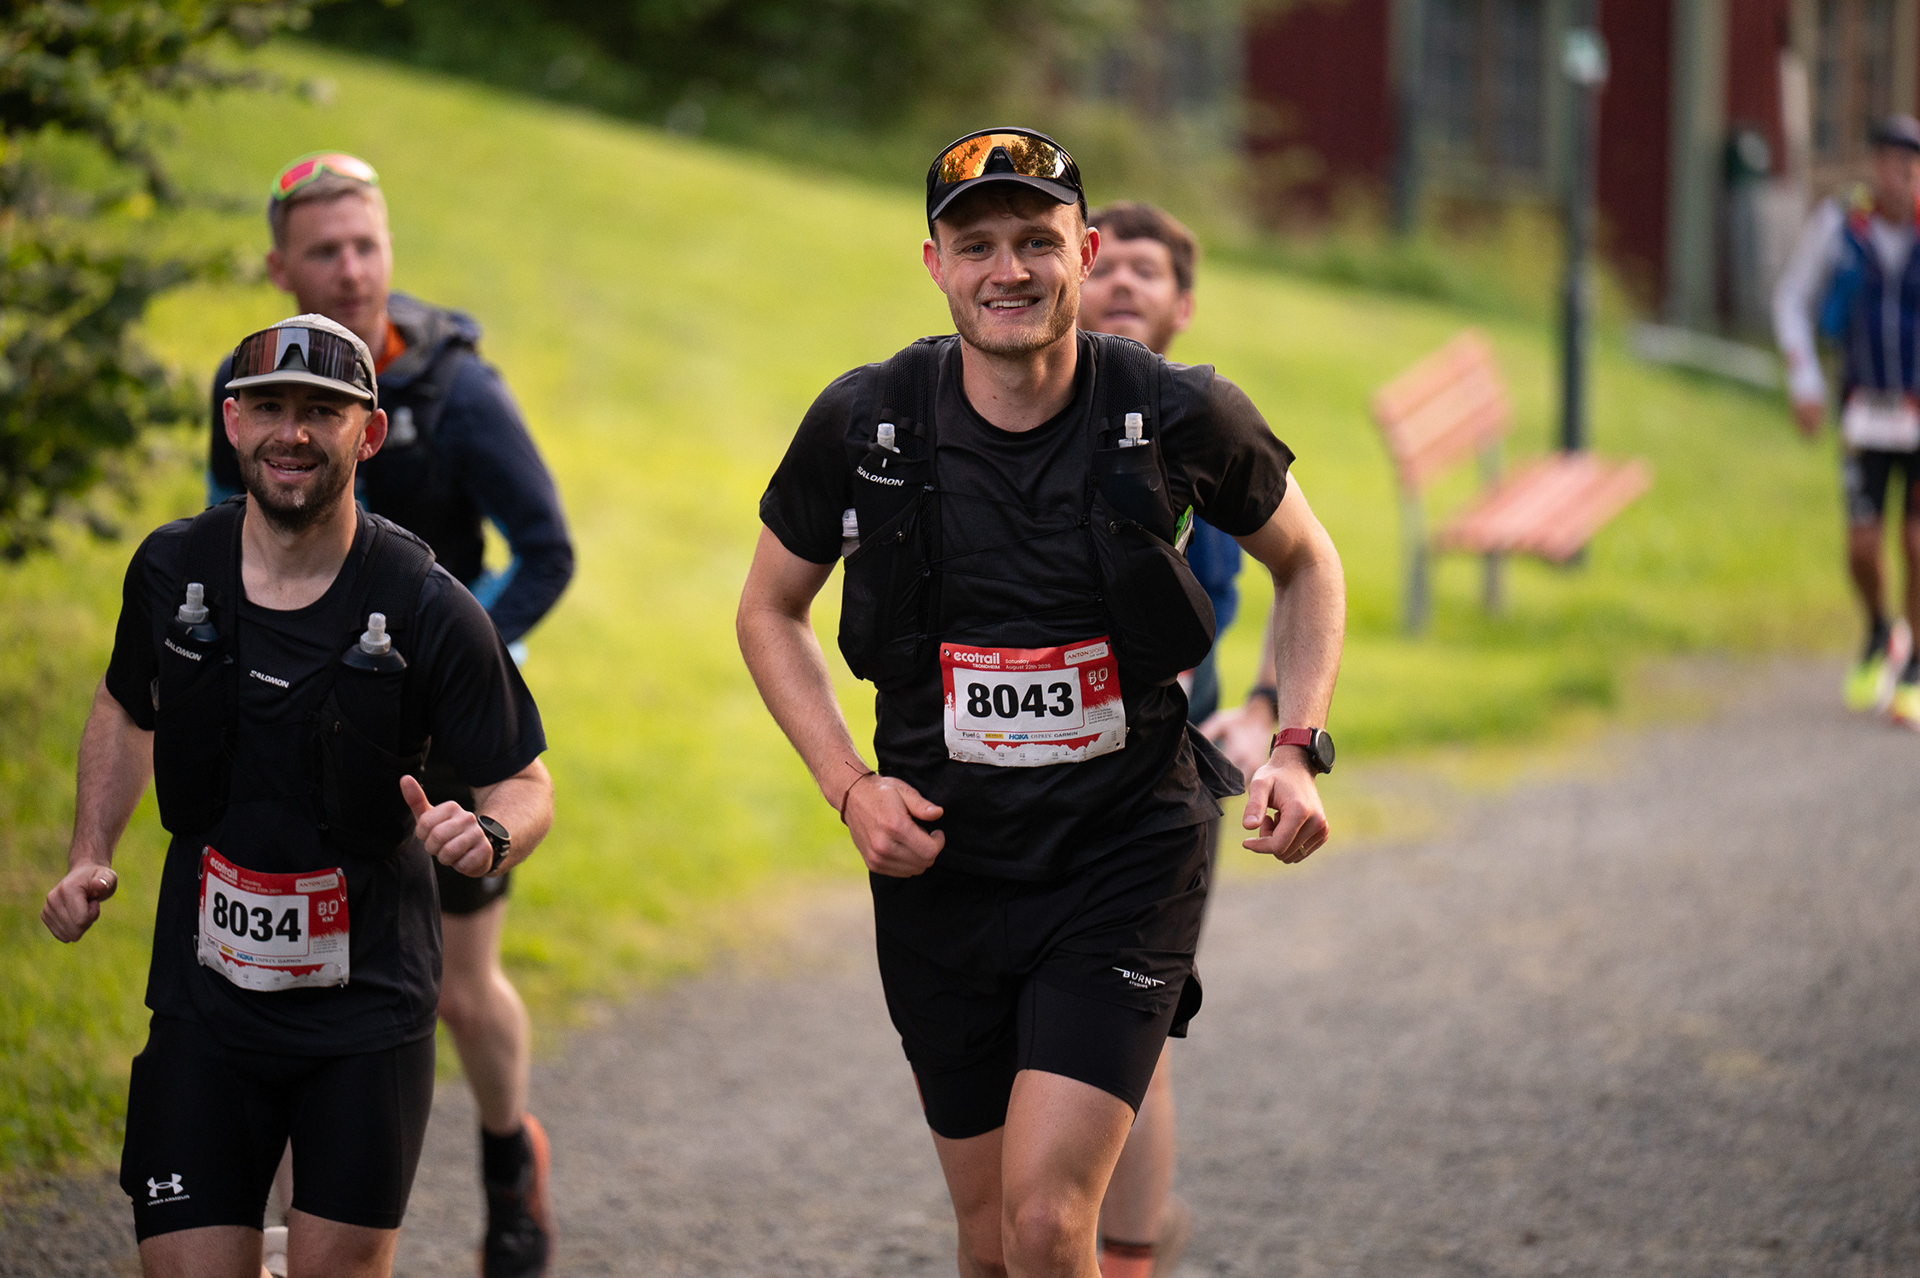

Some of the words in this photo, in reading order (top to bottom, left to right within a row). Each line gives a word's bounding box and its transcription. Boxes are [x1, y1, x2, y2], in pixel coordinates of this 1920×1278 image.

[857, 466, 904, 486] SALOMON
[164, 638, 202, 661] SALOMON
[953, 651, 1000, 664] ecotrail
[249, 669, 290, 688] SALOMON
[1088, 667, 1109, 685] 80
[1094, 683, 1105, 692] KM
[967, 682, 1074, 718] 8043
[210, 857, 238, 880] ecotrail
[213, 891, 301, 942] 8034
[318, 899, 339, 916] 80
[1112, 966, 1166, 987] BURNT
